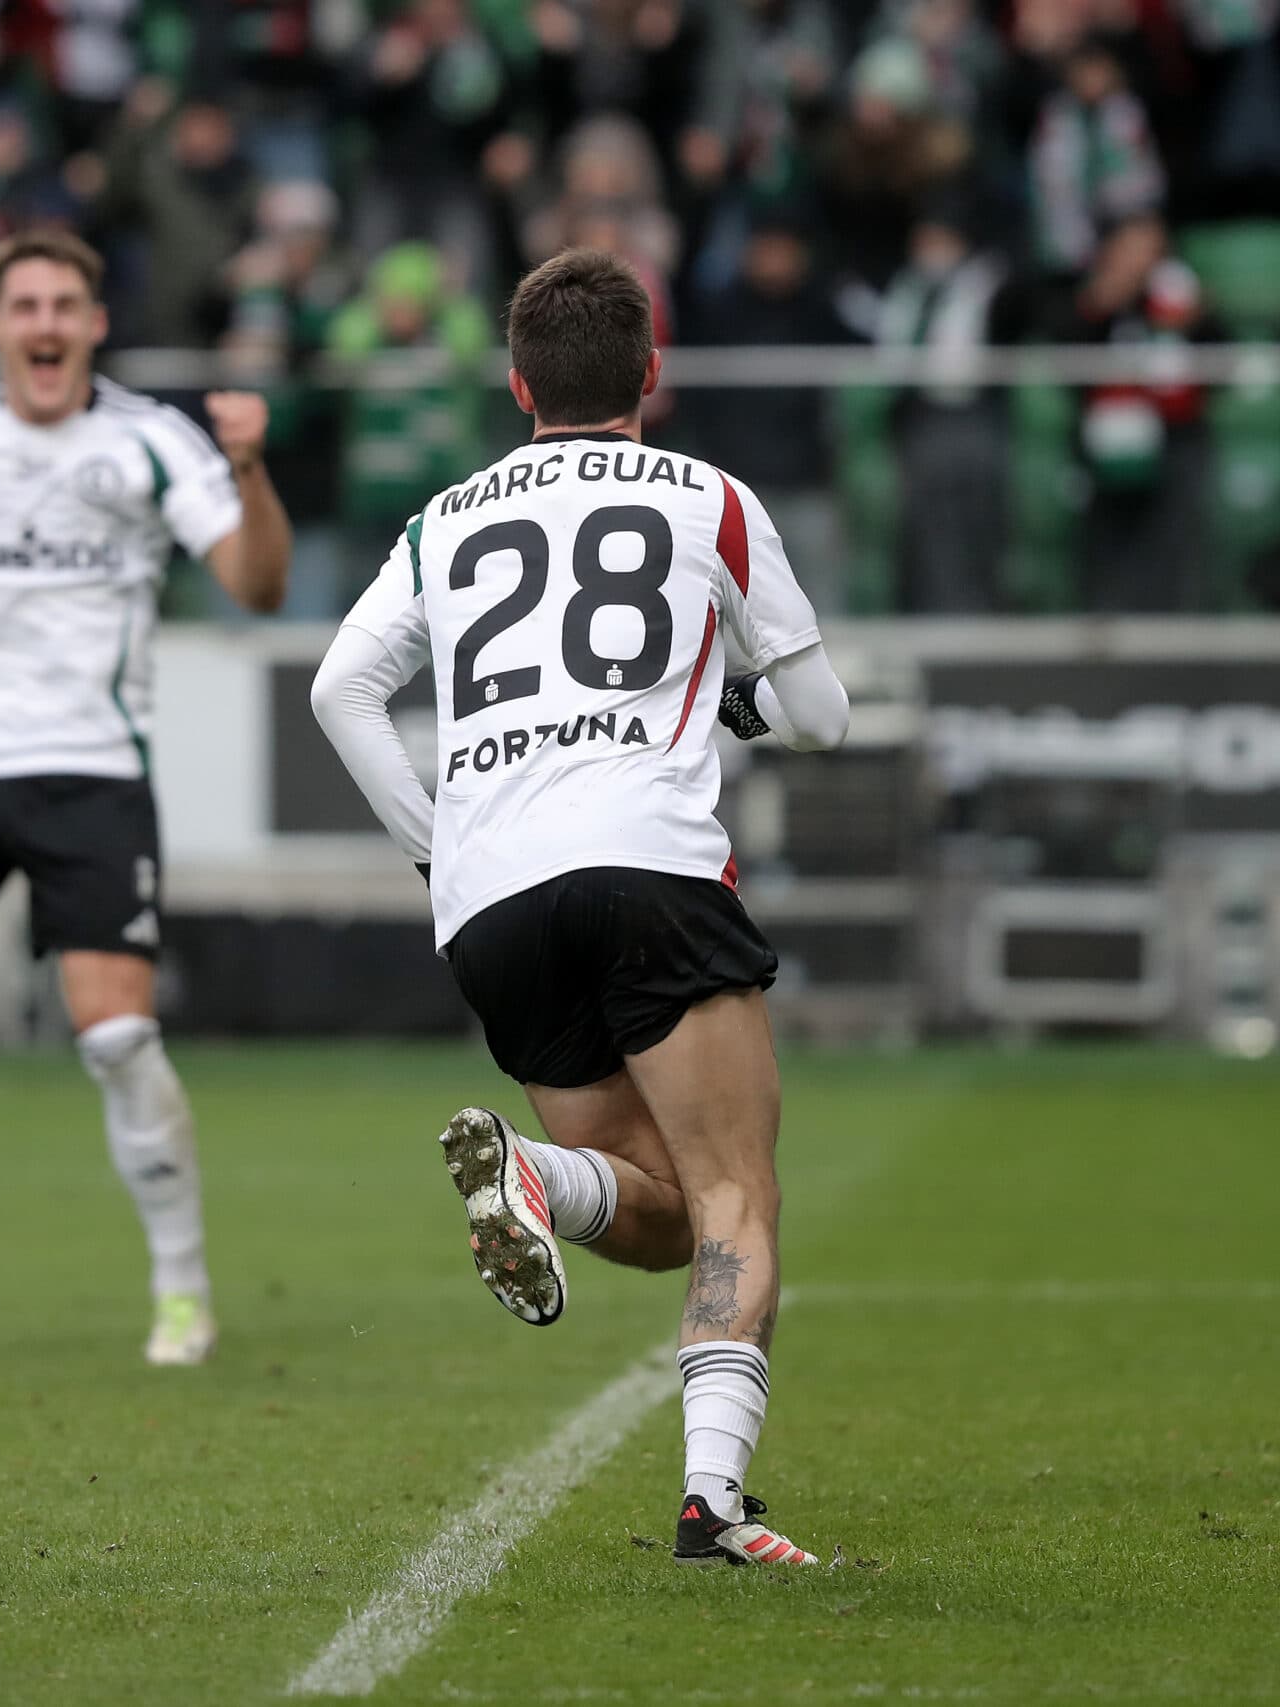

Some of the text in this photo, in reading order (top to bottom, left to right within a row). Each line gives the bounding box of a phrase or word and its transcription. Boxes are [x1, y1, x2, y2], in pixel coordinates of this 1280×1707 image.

[440, 451, 705, 518] MARC GUAL
[448, 504, 674, 722] 28
[446, 712, 651, 783] FORTUNA
